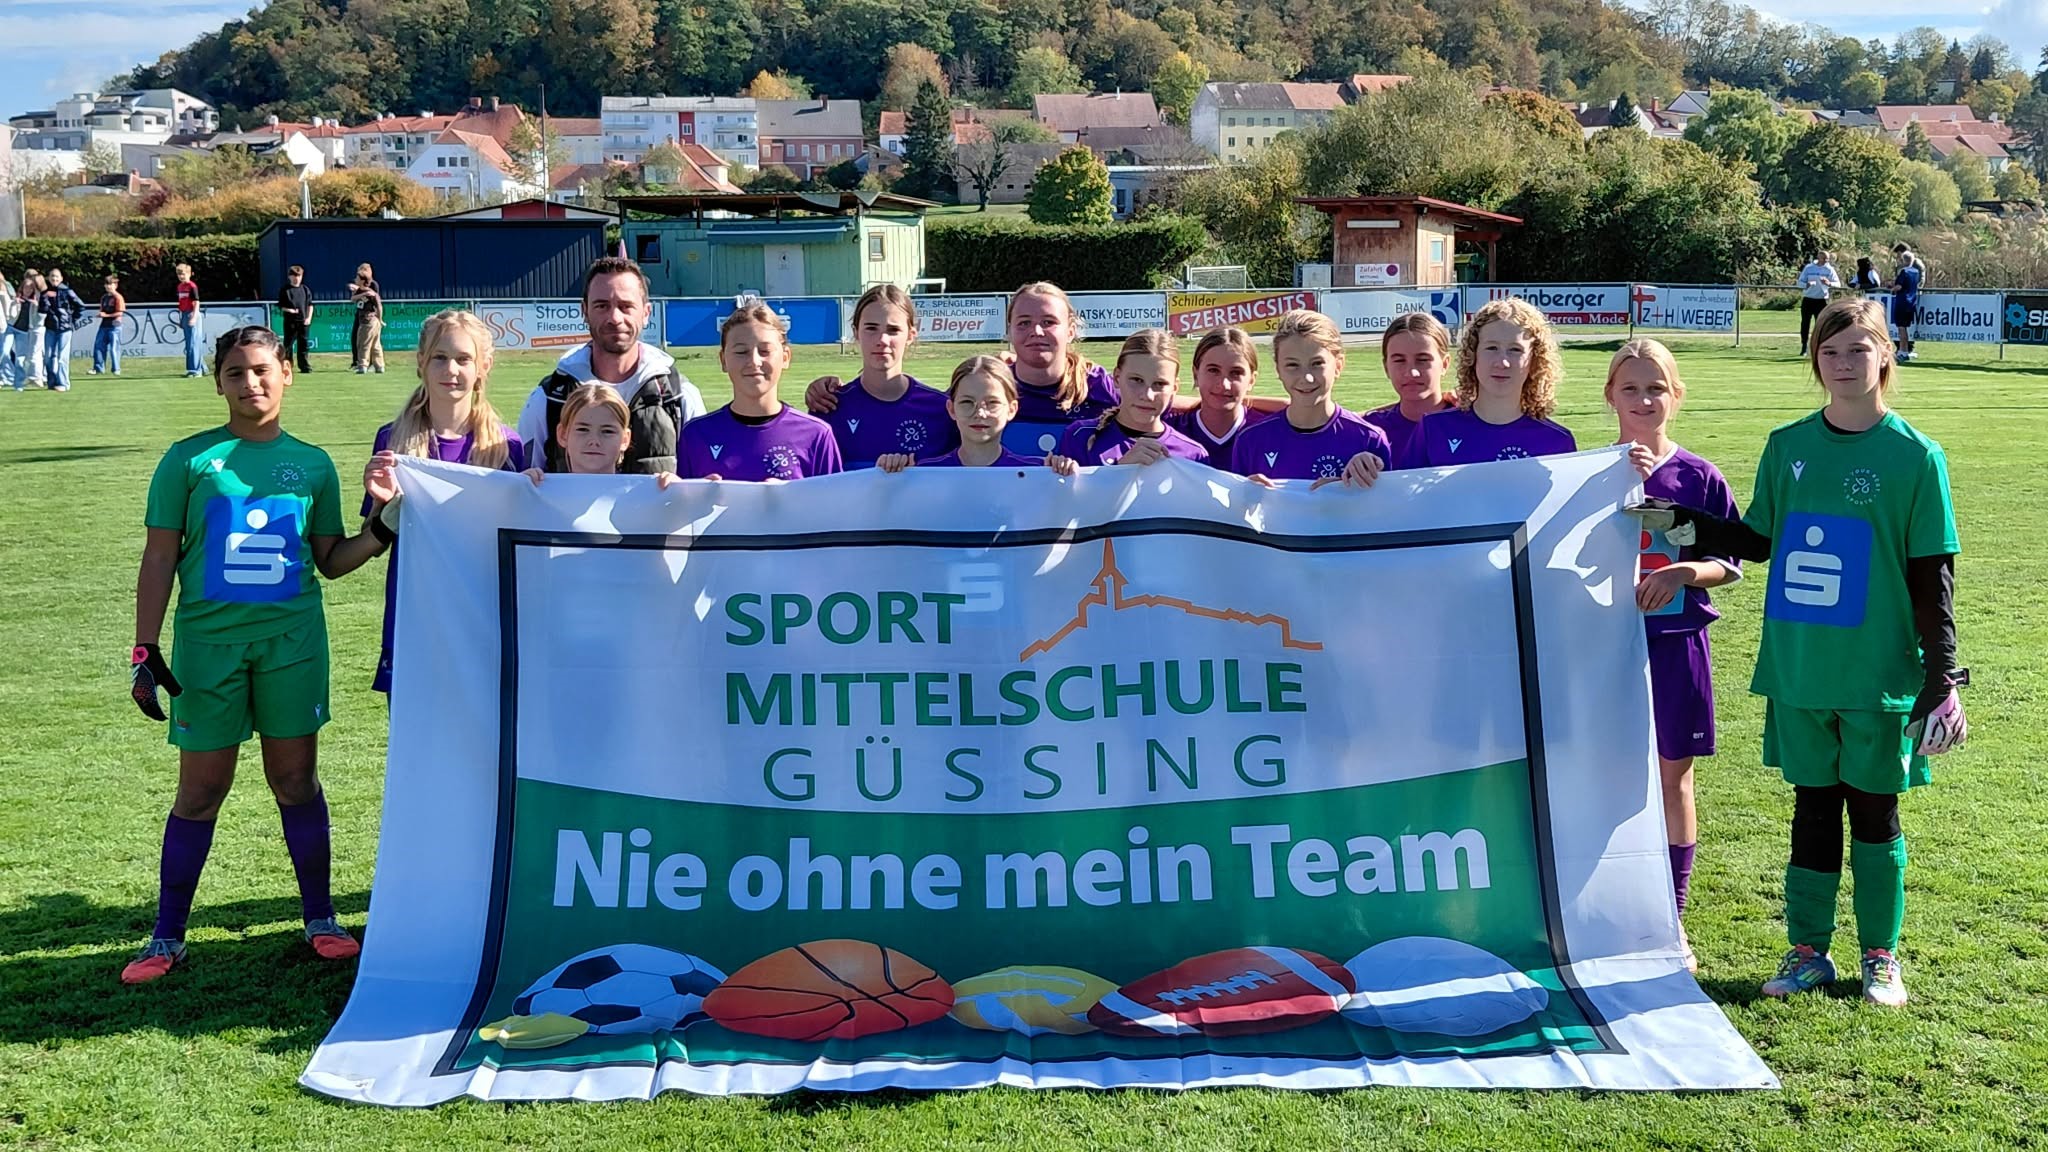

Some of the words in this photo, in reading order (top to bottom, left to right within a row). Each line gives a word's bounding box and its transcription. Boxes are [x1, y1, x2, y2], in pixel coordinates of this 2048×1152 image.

[932, 299, 984, 308] SPENGLEREI
[1172, 295, 1216, 307] Schilder
[1395, 302, 1425, 314] BANK
[1180, 293, 1307, 332] SZERENCSITS
[1545, 314, 1583, 325] erren
[1588, 313, 1626, 324] Mode
[1681, 308, 1734, 327] WEBER
[1913, 306, 1994, 327] Metallbau
[931, 318, 984, 334] Bleyer
[1345, 316, 1395, 329] BURGEN
[1945, 331, 1966, 341] 03322
[725, 591, 966, 647] SPORT
[725, 658, 1308, 727] MITTELSCHULE
[762, 734, 1287, 802] GÜSSING
[552, 827, 708, 911] Nie
[727, 836, 963, 912] ohne
[985, 825, 1214, 909] mein
[1229, 823, 1492, 899] Team
